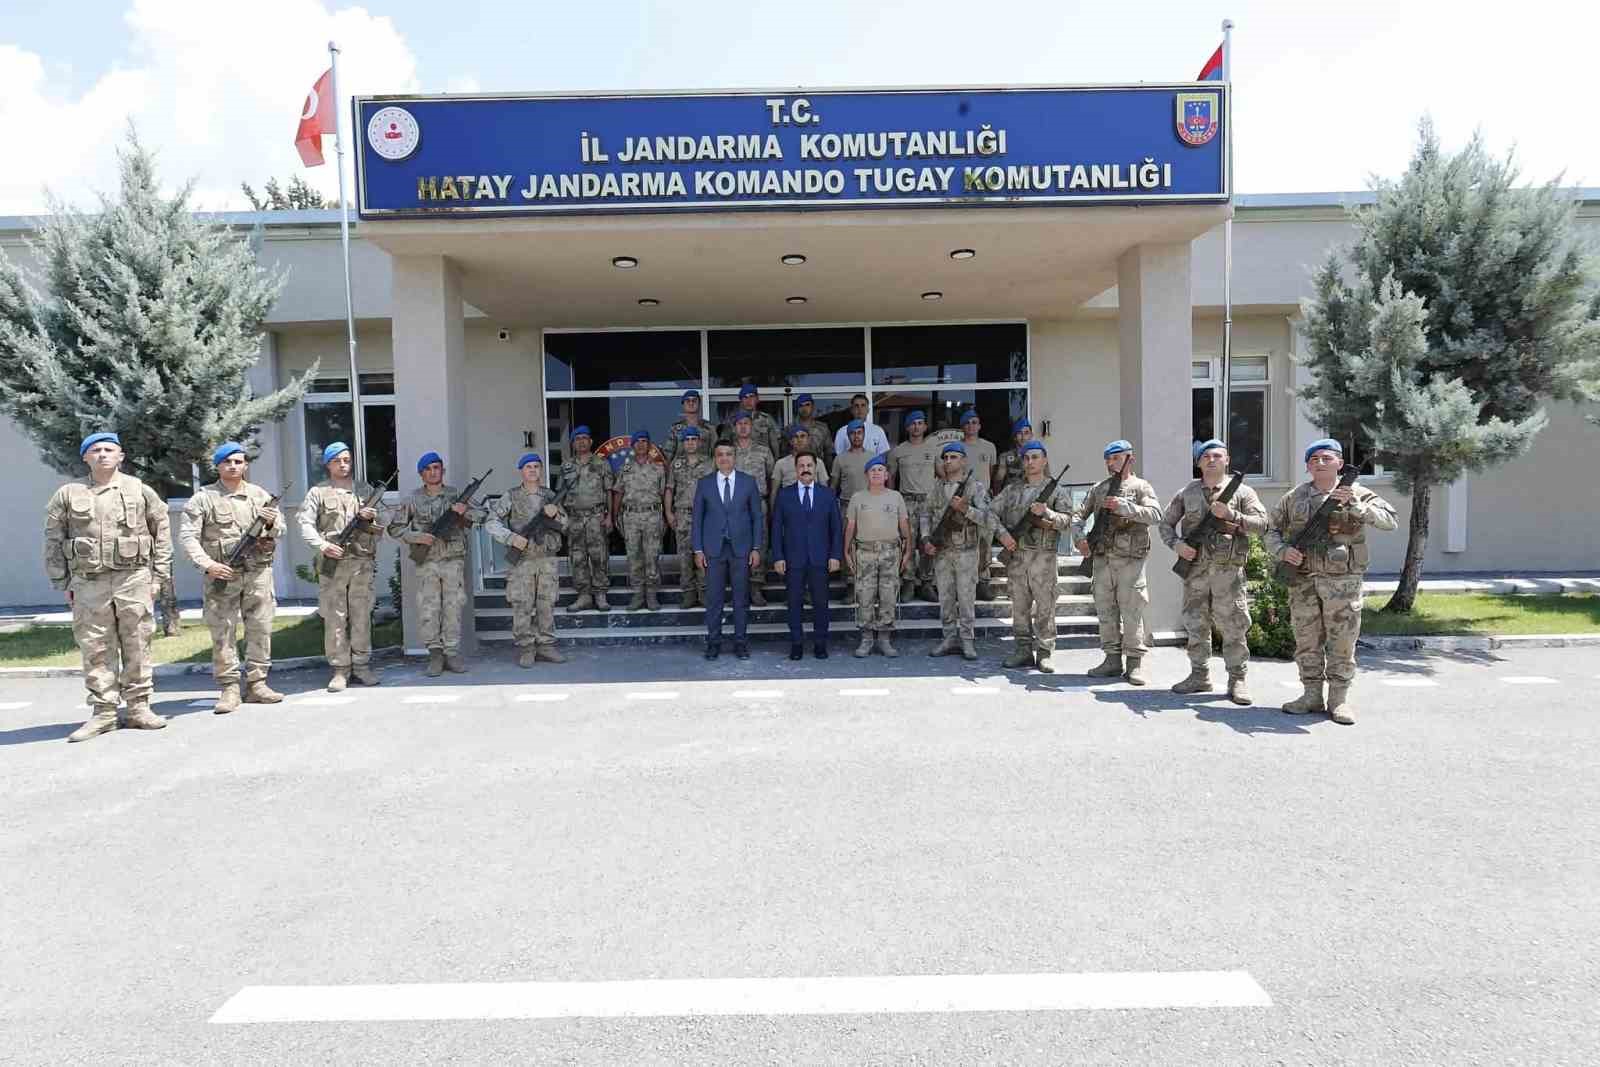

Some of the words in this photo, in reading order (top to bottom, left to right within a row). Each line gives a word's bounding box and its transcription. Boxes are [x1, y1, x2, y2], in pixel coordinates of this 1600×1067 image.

[766, 98, 820, 123] T.C.
[581, 131, 608, 162] İL
[618, 134, 783, 161] JANDARMA
[801, 124, 1007, 158] KOMUTANLIĞI
[417, 175, 512, 200] HATAY
[521, 172, 688, 198] JANDARMA
[695, 170, 844, 196] KOMANDO
[854, 167, 954, 193] TUGAY
[964, 157, 1172, 191] KOMUTANLIĞI
